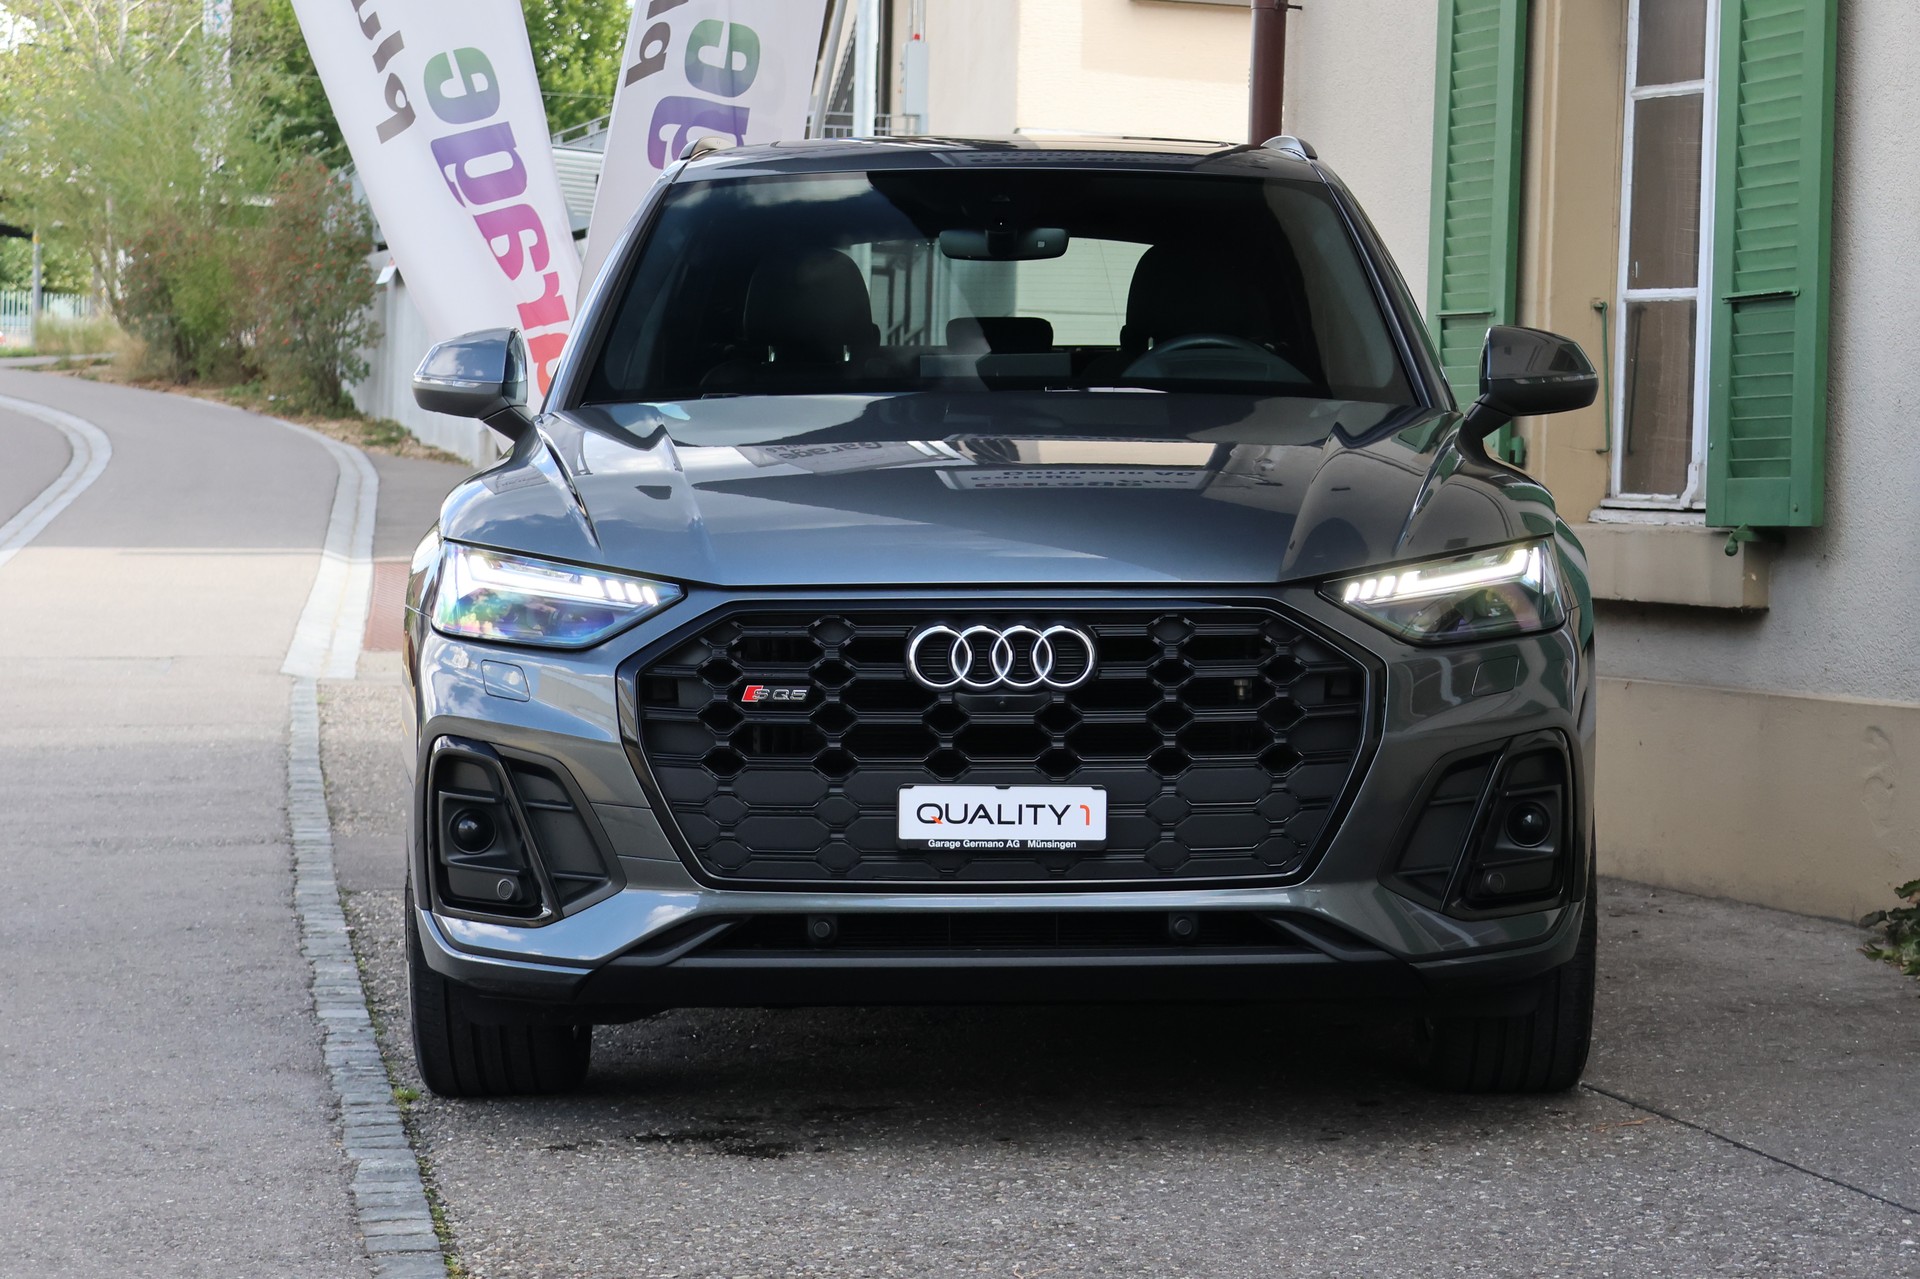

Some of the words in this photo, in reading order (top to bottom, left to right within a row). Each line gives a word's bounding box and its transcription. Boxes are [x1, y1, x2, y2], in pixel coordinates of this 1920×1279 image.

[916, 803, 1072, 825] QUALITY
[1079, 804, 1091, 826] 1
[928, 839, 960, 849] Garage
[963, 839, 1005, 848] Germano
[1006, 839, 1020, 848] AG
[1027, 839, 1077, 849] Münsingen
